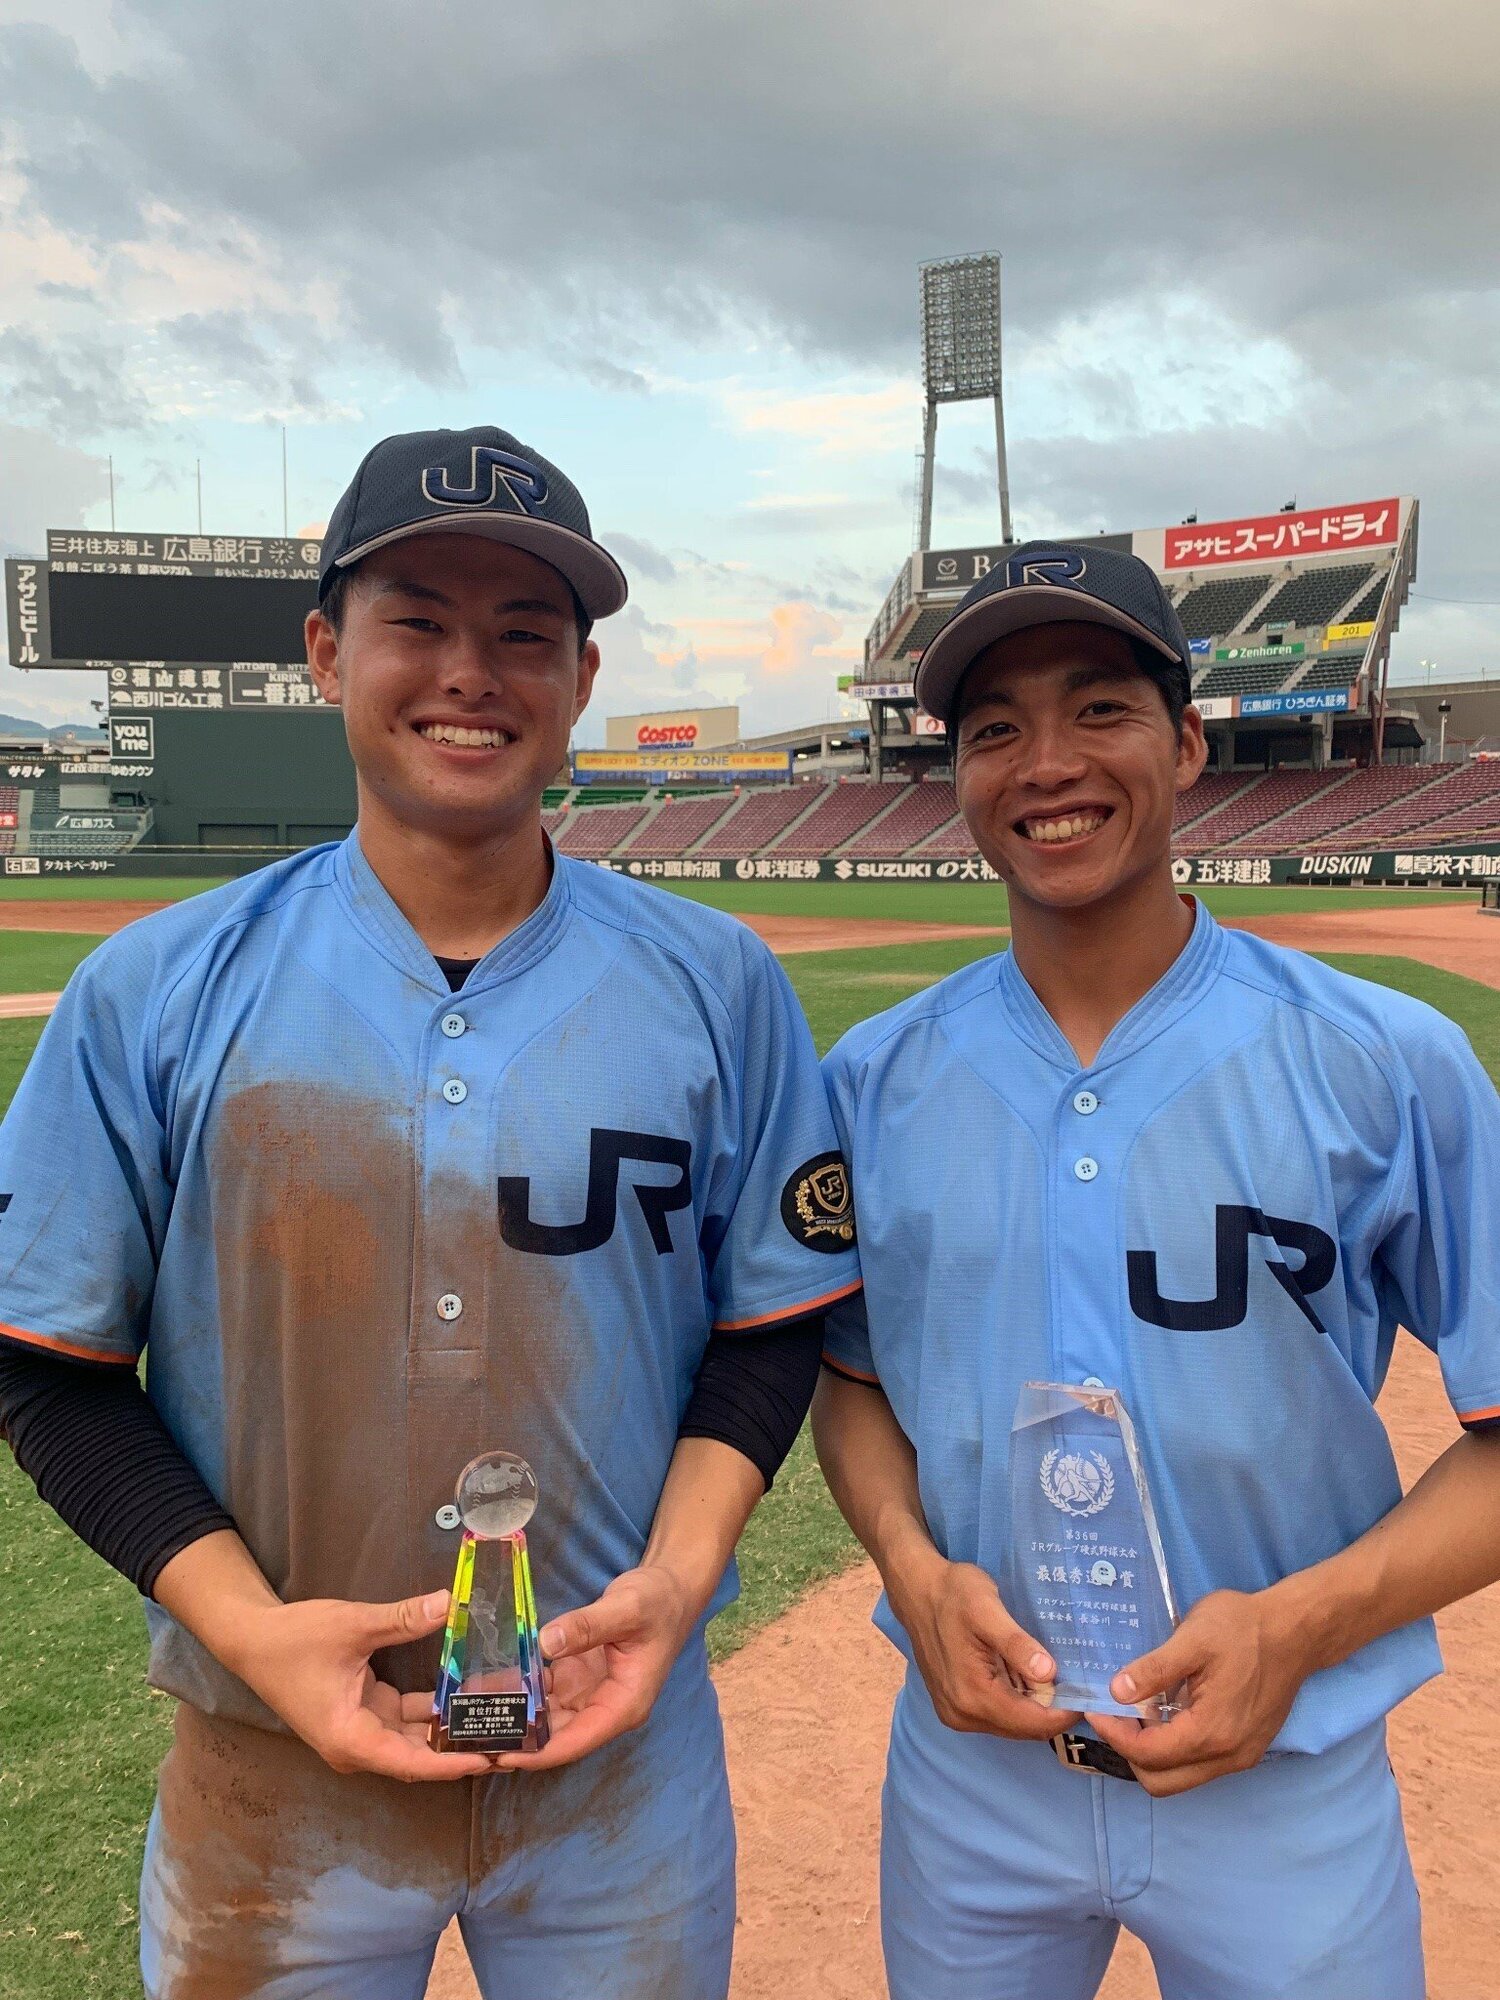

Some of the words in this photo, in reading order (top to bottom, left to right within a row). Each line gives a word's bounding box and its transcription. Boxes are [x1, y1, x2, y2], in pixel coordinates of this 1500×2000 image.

[422, 446, 548, 516] JR
[50, 537, 156, 556] 三井住友海上
[163, 536, 263, 563] 広島銀行
[17, 565, 39, 663] アサヒビール
[1342, 627, 1360, 636] 201
[1240, 645, 1292, 658] Zenhoren
[269, 673, 301, 682] KIRIN
[132, 691, 223, 708] 西川ゴム工業
[1242, 699, 1281, 713] 広島銀行
[1286, 694, 1347, 709] ひろぎん証券
[114, 725, 146, 738] you
[638, 725, 697, 743] COSTCO
[121, 738, 148, 750] me
[640, 757, 689, 766] エディオン
[693, 757, 729, 766] ZONE
[8, 765, 45, 778] サタケ
[111, 764, 154, 777] ゆめタウン
[70, 817, 115, 829] 広島ガス
[45, 860, 116, 871] タカキベーカリー
[755, 860, 820, 878] 東洋証券
[856, 863, 931, 877] SUZUKI
[1197, 860, 1271, 883] 五洋建設
[1300, 856, 1373, 875] DUSKIN
[498, 1128, 692, 1256] JR
[1127, 1204, 1336, 1333] JR
[1065, 1529, 1099, 1541] 第36回
[468, 1706, 510, 1716] 首位打者賞
